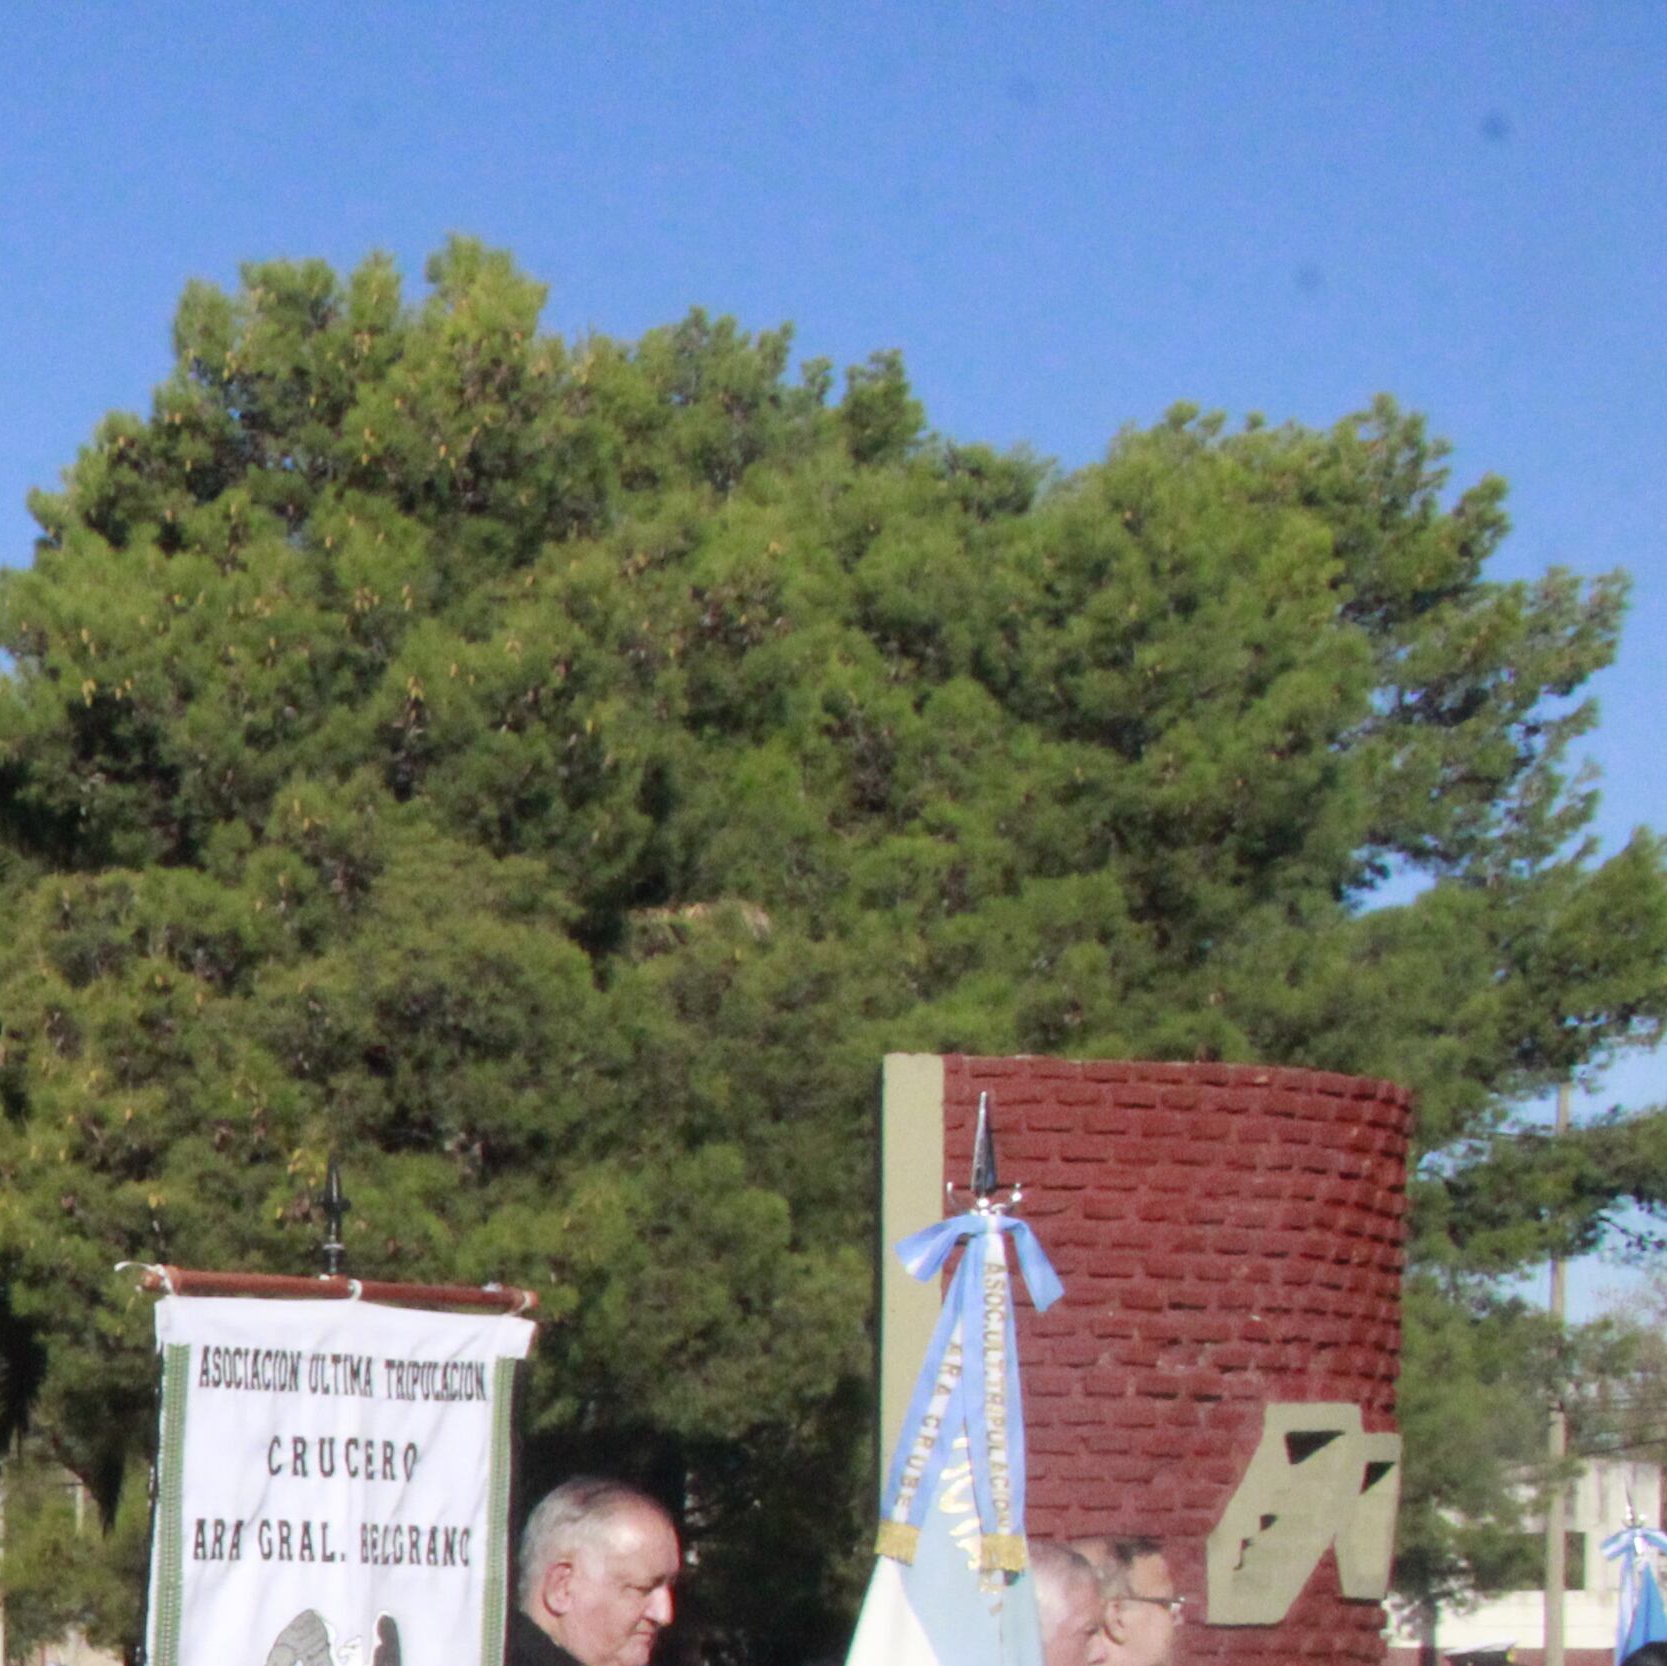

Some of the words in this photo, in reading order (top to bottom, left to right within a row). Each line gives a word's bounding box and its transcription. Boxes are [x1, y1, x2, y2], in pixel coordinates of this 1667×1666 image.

[199, 1345, 301, 1392] ASOCIACION
[308, 1352, 373, 1397] ULTIMA
[384, 1358, 485, 1401] TRIPULACION
[267, 1435, 419, 1482] CRUCERO
[193, 1518, 244, 1561] ARA
[258, 1518, 346, 1563] GRAL.
[360, 1522, 473, 1567] BELGRANO
